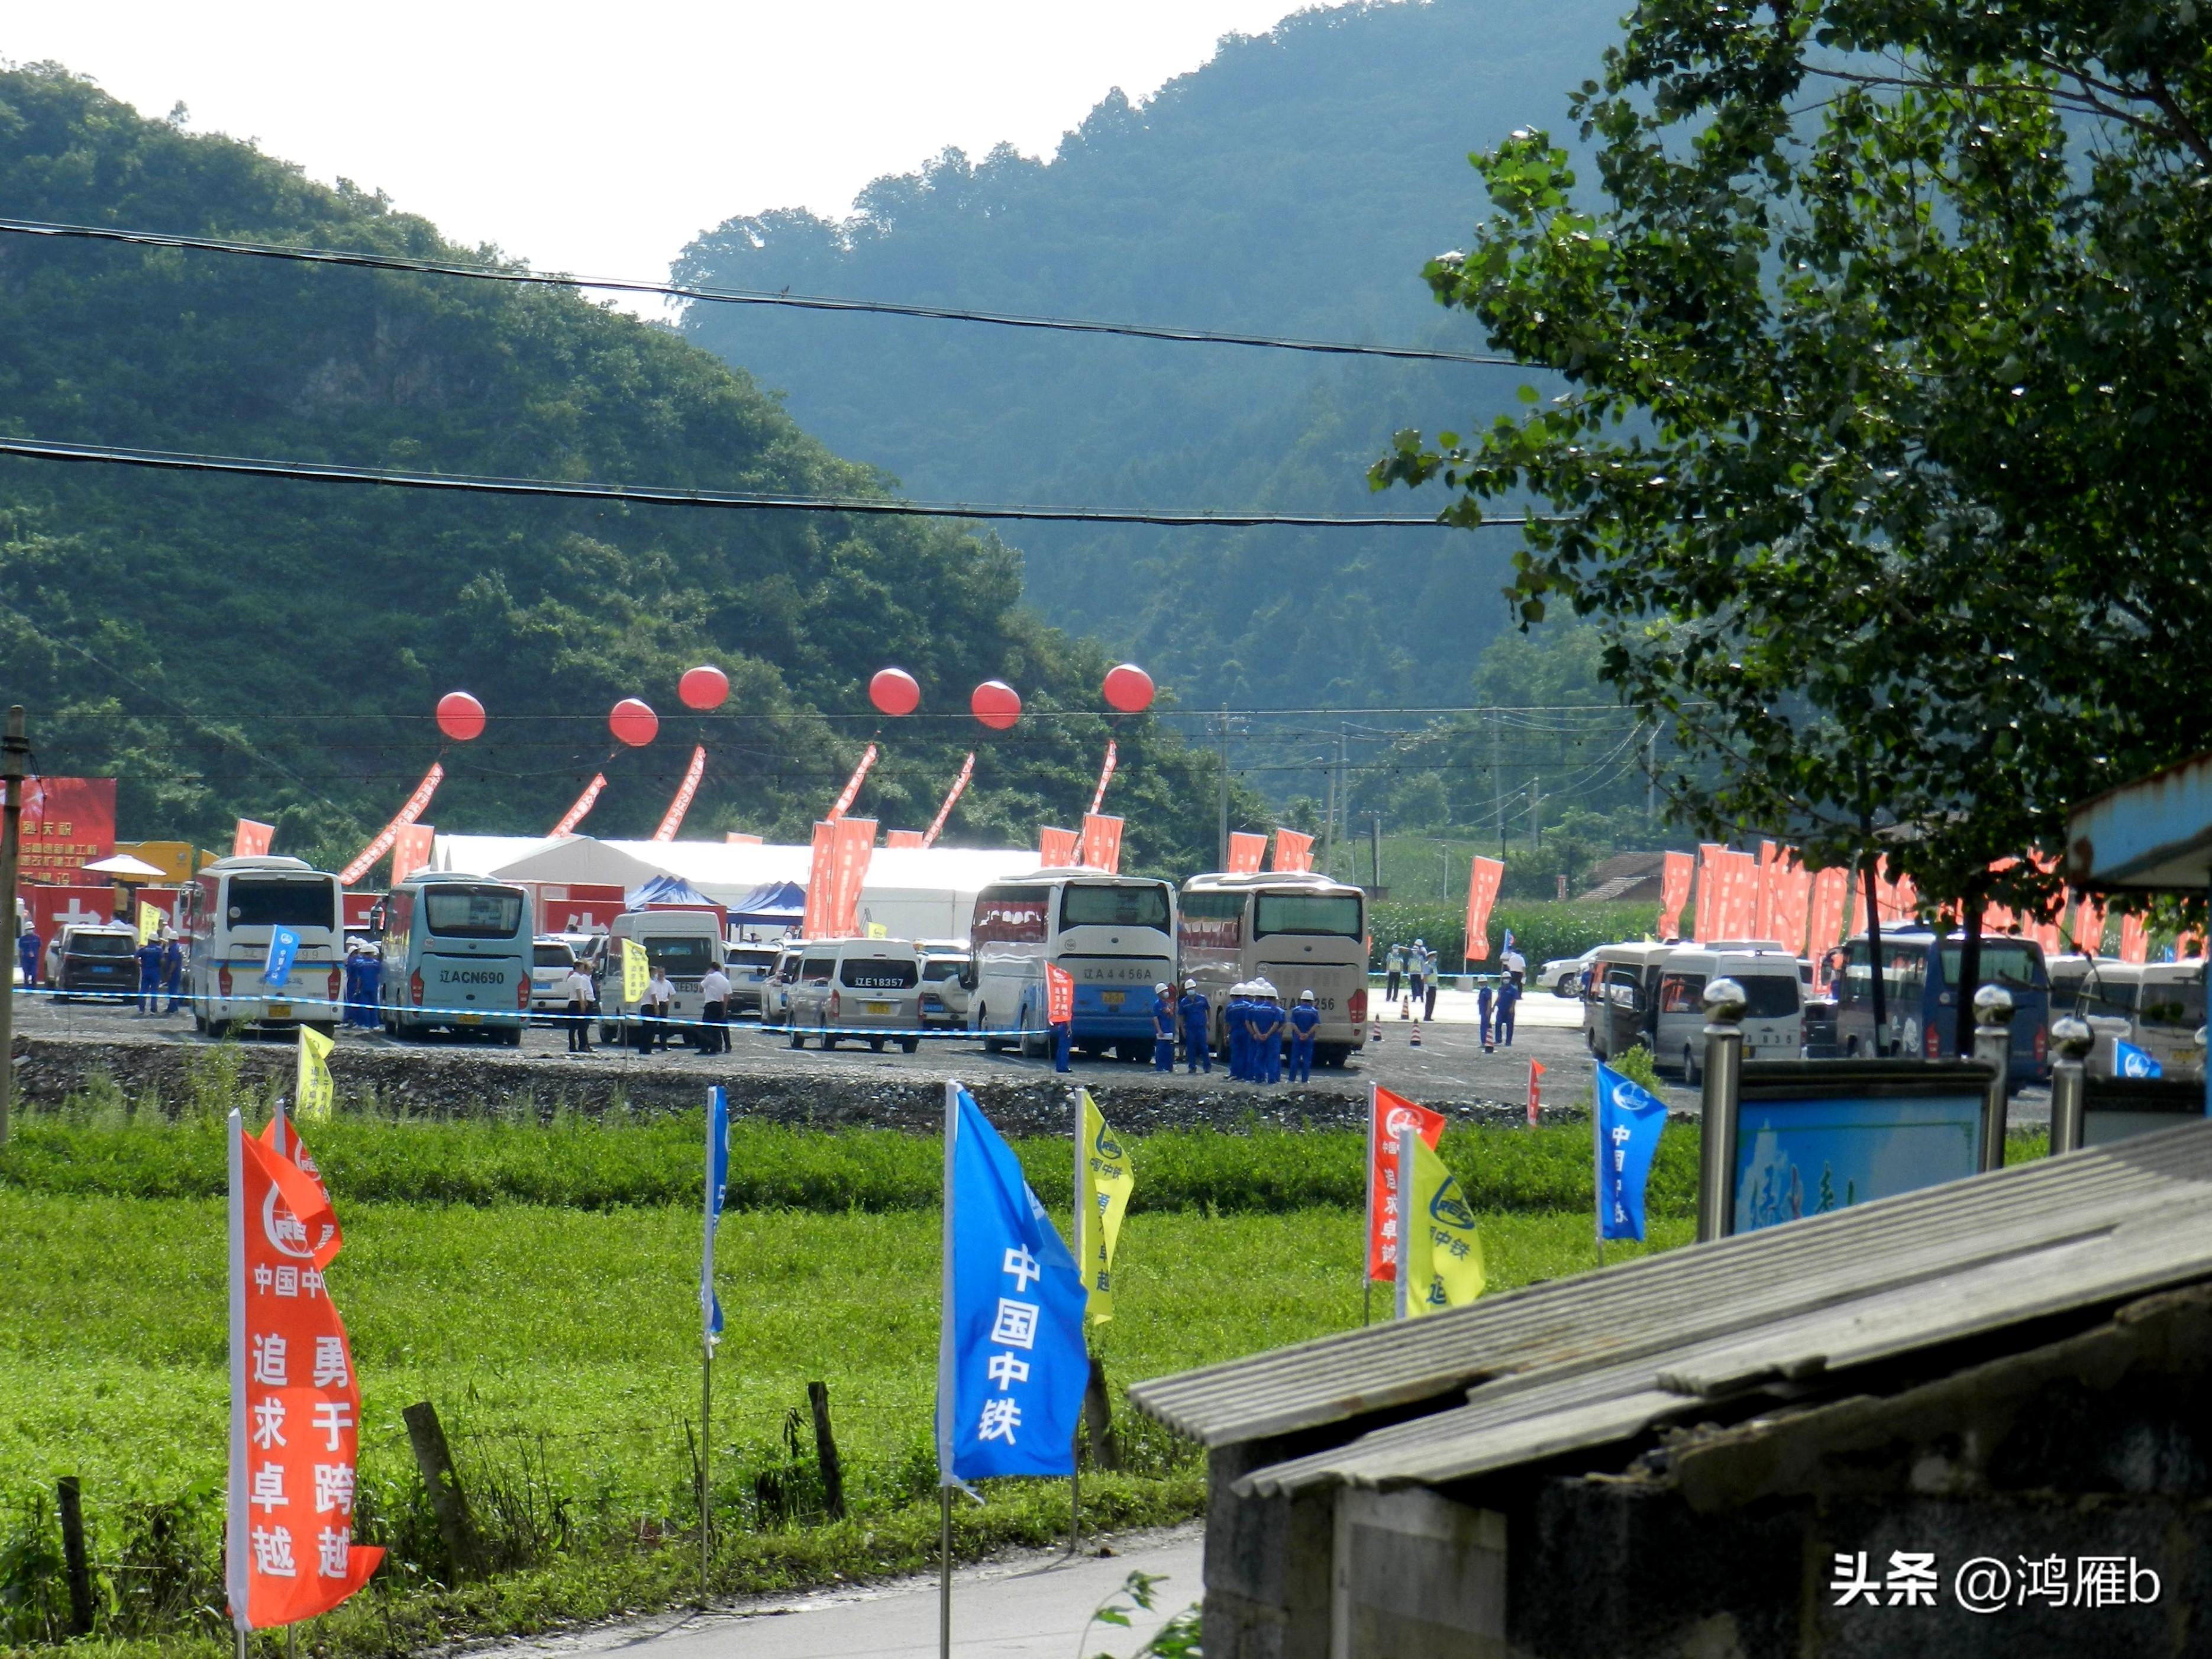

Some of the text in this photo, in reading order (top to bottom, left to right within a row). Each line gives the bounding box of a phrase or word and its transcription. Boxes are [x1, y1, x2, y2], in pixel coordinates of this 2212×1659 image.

[440, 970, 504, 985] 辽ACN690
[855, 977, 904, 987] 辽E18357
[979, 1243, 1040, 1445] 中国中铁
[251, 1333, 296, 1577] 追求卓越
[312, 1336, 354, 1579] 勇于跨越
